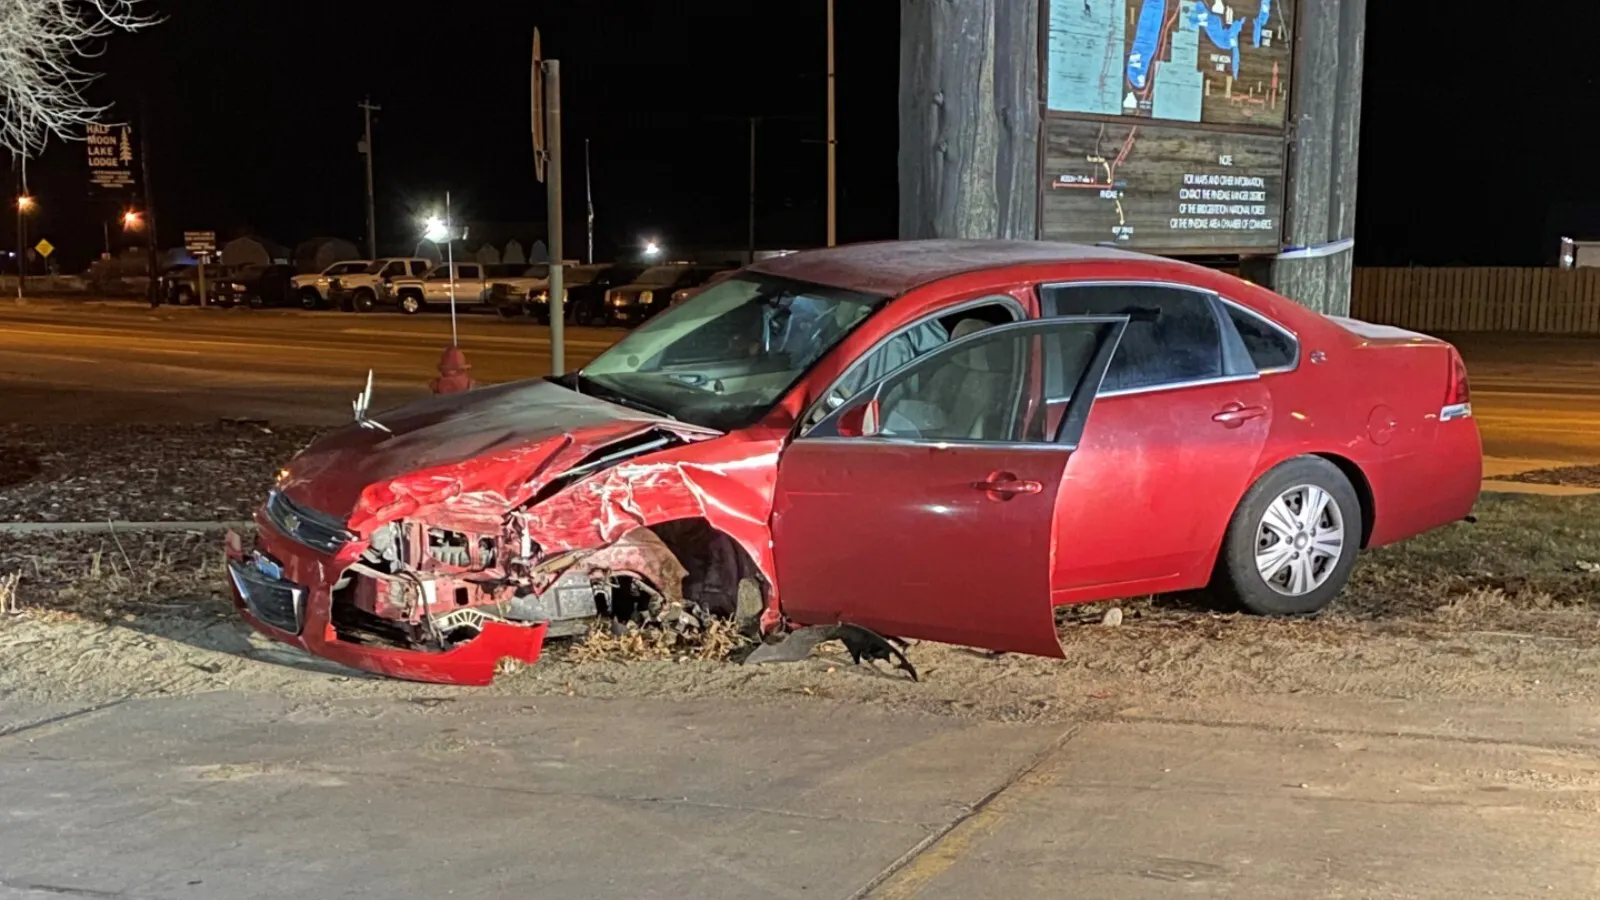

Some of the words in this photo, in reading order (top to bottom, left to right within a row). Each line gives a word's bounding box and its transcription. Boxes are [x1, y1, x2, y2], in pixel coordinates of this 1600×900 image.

[87, 123, 110, 134] HALF
[88, 135, 117, 145] MOON
[88, 146, 114, 156] LAKE
[89, 157, 118, 167] LODGE
